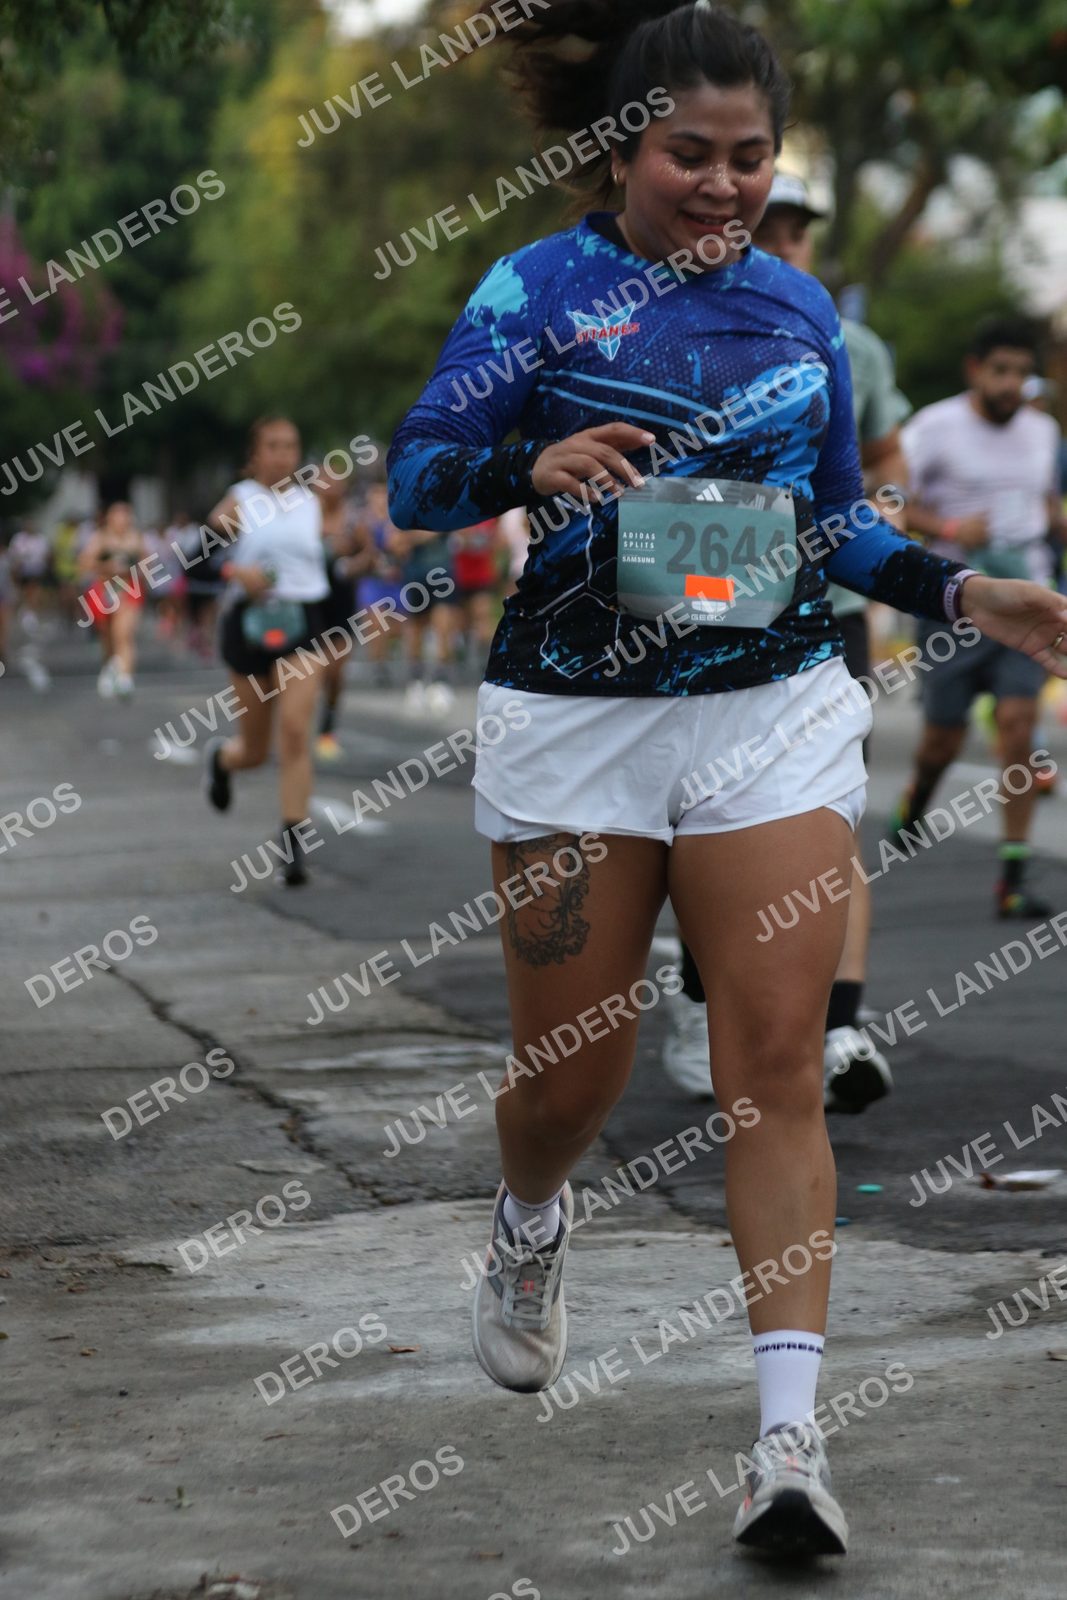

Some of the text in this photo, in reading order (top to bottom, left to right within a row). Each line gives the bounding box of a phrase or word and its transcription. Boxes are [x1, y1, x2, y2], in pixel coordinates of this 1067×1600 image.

[623, 531, 656, 540] ADIDAS
[623, 541, 655, 549] SPLITS
[622, 556, 656, 564] SAMSUNG
